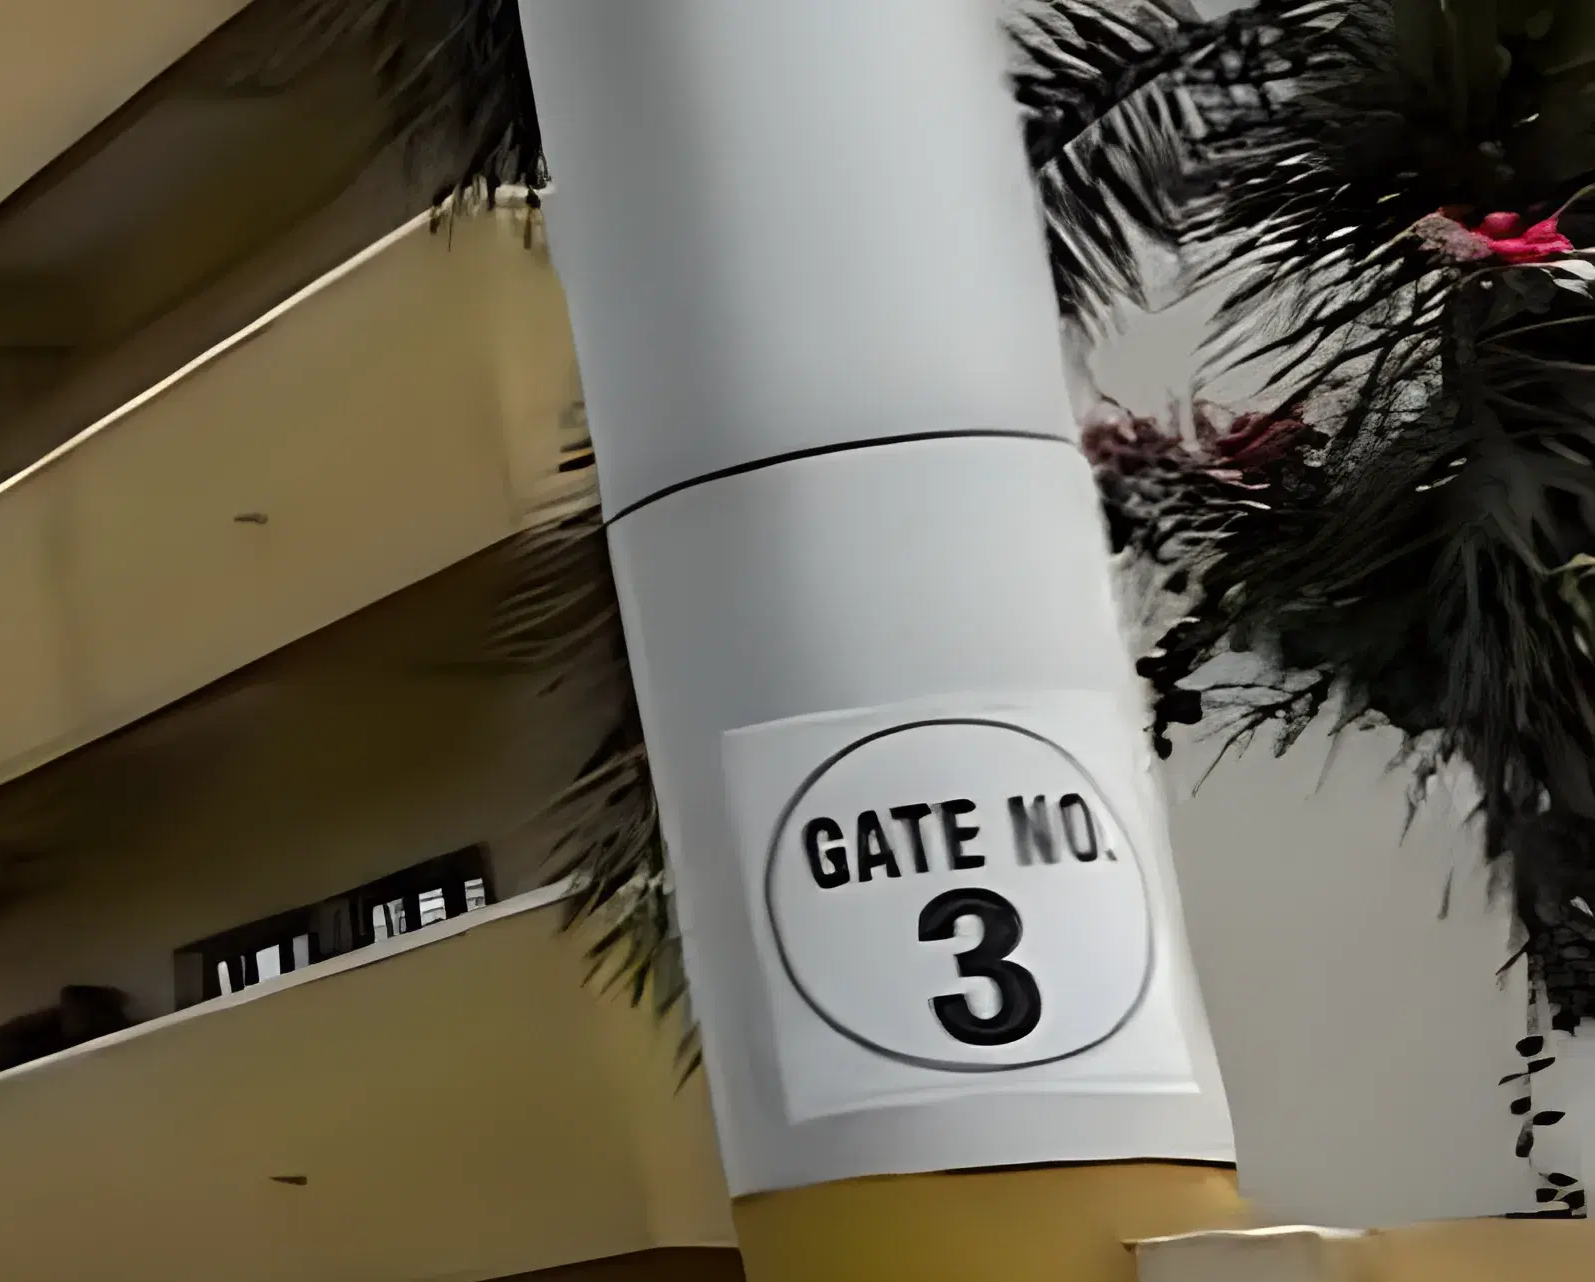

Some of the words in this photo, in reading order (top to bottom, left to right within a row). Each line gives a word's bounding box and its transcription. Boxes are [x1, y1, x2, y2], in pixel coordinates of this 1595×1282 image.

[802, 798, 986, 889] GATE
[1008, 793, 1119, 867] NO.
[918, 887, 1043, 1046] 3
